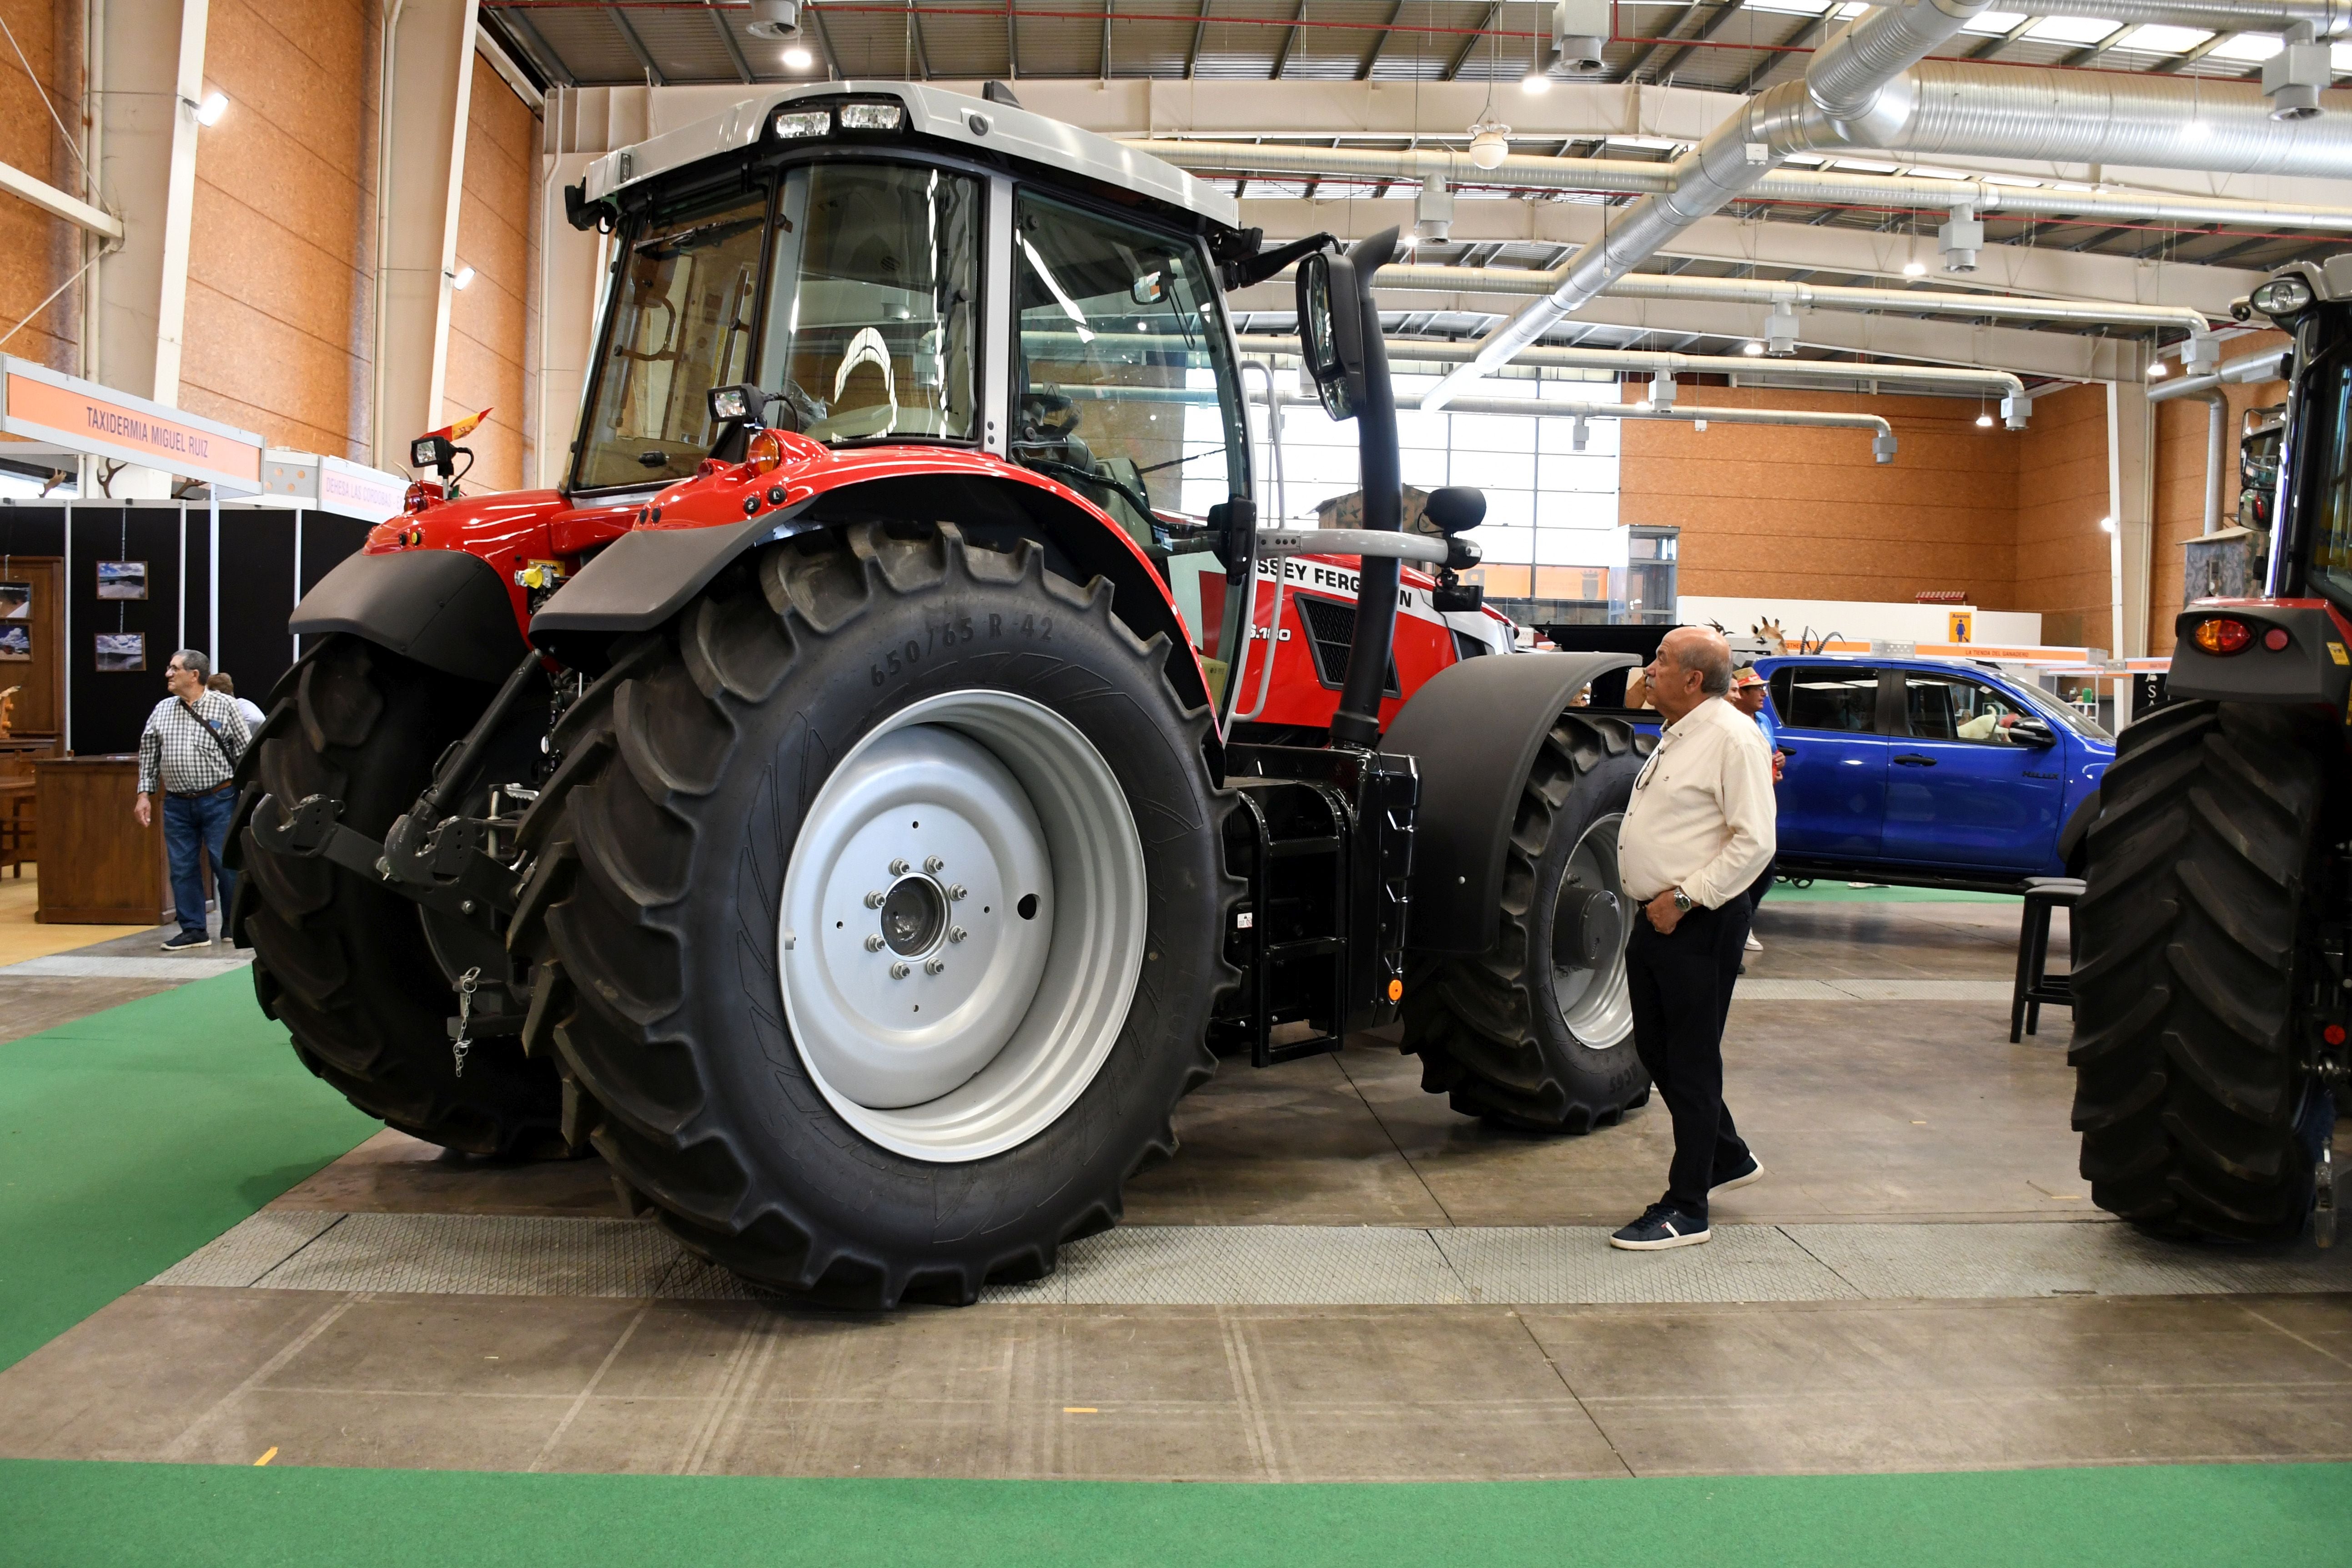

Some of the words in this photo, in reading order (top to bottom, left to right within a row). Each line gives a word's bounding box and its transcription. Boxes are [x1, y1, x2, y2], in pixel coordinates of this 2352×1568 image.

[86, 406, 148, 442] TAXIDERMIA
[151, 425, 186, 452] MIGUEL
[189, 436, 208, 458] RUIZ
[351, 484, 362, 500] LAS
[1257, 558, 1307, 581] SSEY
[988, 613, 1002, 639] R
[1020, 613, 1054, 642] 42
